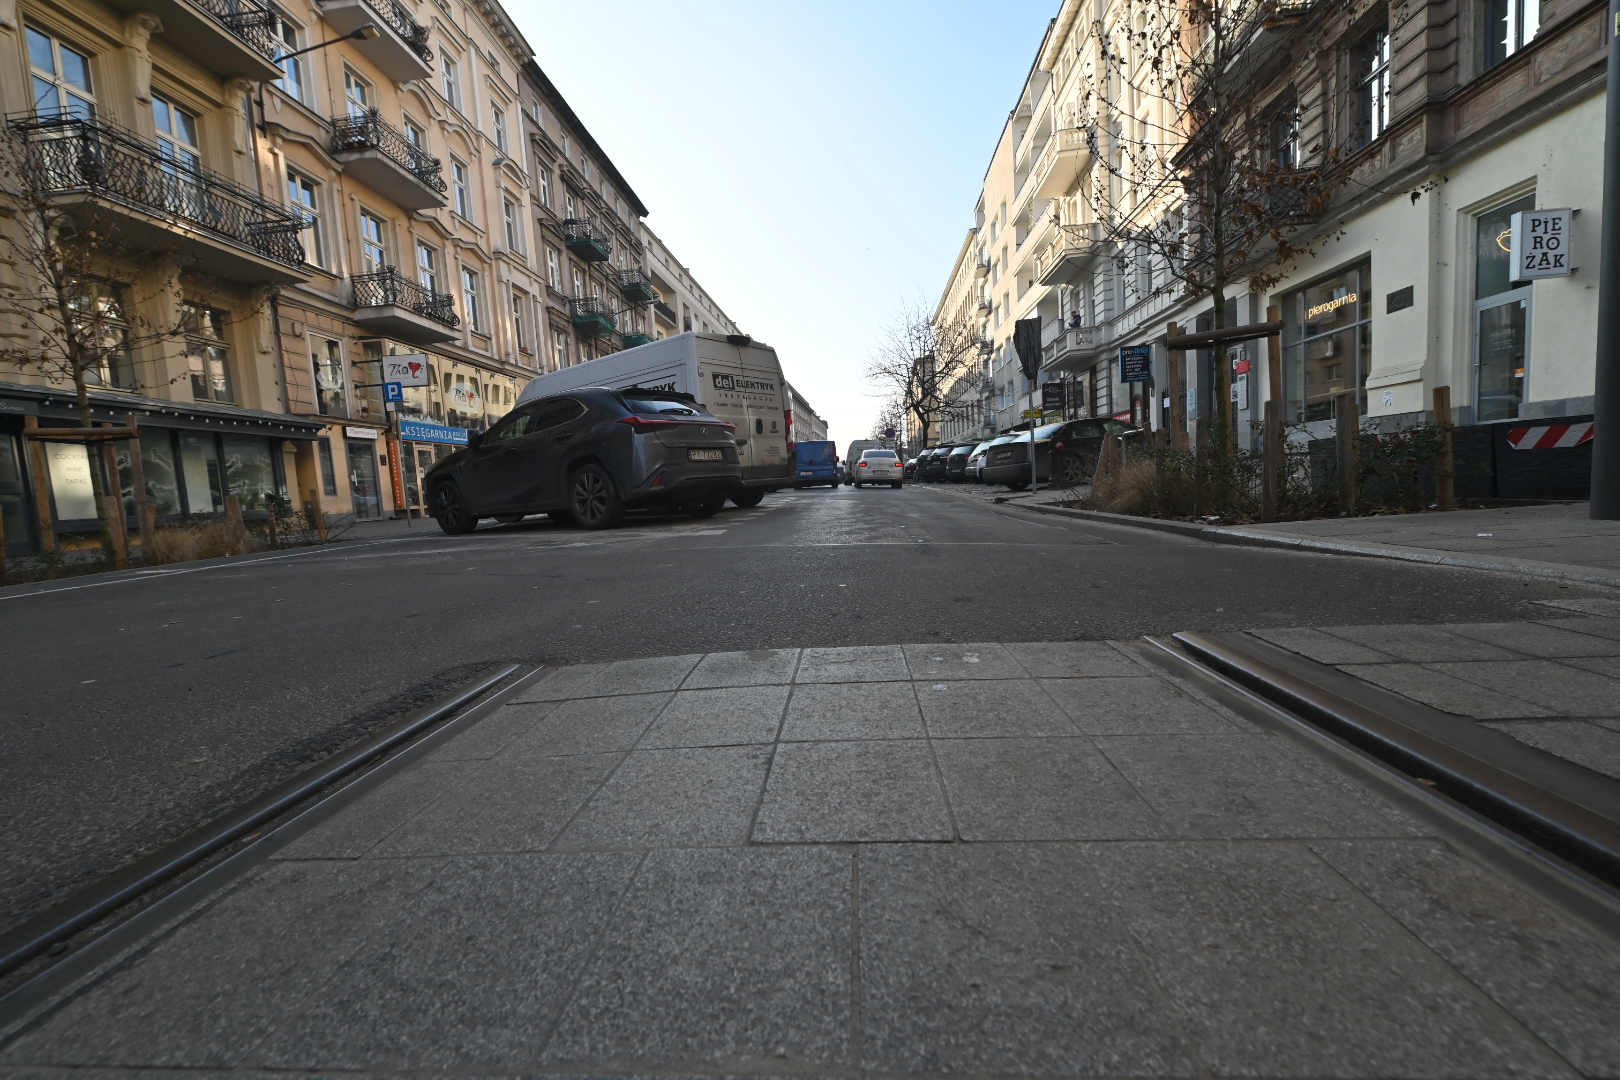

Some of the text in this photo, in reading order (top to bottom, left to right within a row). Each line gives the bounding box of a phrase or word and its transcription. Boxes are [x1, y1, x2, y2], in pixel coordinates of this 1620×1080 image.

[1532, 236, 1560, 251] RO
[1525, 252, 1565, 270] ŻAK
[1308, 292, 1357, 320] pierogarnia
[387, 384, 399, 400] P
[715, 376, 775, 392] del ELEKTRYK
[405, 425, 453, 440] KSIĘGARNIA
